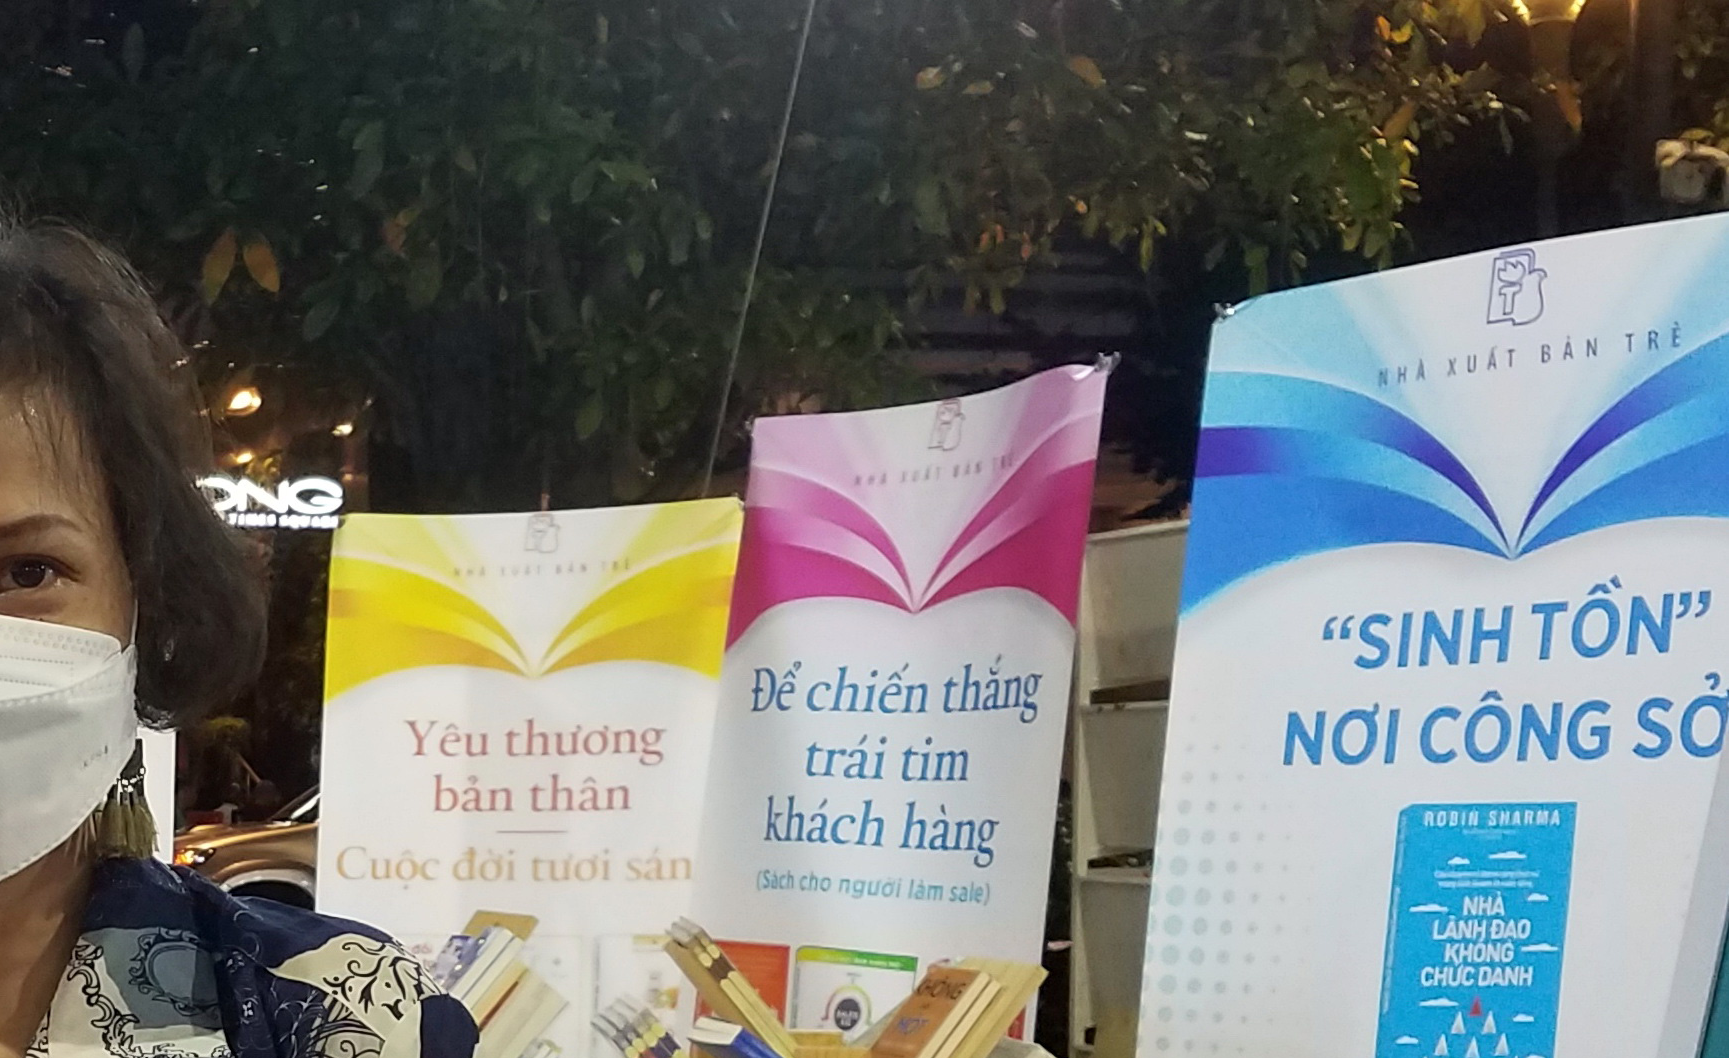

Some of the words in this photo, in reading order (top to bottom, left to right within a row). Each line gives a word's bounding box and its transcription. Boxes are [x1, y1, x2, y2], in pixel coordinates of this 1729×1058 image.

[1378, 362, 1428, 387] NHÀ
[1447, 345, 1517, 377] XUẤT
[1540, 336, 1599, 364] BẢN
[1625, 320, 1683, 353] TRẺ
[752, 661, 802, 712] Để
[806, 663, 928, 714] chiến
[943, 654, 1042, 724] thắng
[1283, 704, 1400, 766] NƠI
[1419, 691, 1612, 763] CÔNG
[1633, 672, 1729, 759] SỞ
[405, 719, 489, 758] Yêu
[505, 718, 667, 766] thương
[806, 735, 886, 780] trái
[901, 737, 968, 781] tim
[434, 774, 513, 813] bản
[530, 773, 632, 812] thân
[763, 796, 885, 847] khách
[899, 802, 999, 868] hàng
[1424, 810, 1479, 827] ROBIN
[1488, 809, 1561, 826] SHARMA
[336, 846, 438, 890] Cuộc
[452, 846, 516, 882] đời
[531, 848, 610, 882] tươi
[756, 870, 794, 890] (Sách
[799, 872, 831, 892] cho
[838, 876, 901, 898] người
[908, 879, 943, 900] làm
[949, 883, 991, 906] sale)
[1463, 890, 1505, 916] NHÀ
[1433, 916, 1486, 941] LÃNH
[1444, 938, 1514, 964] KHÔNG
[1421, 962, 1475, 987] CHỨC
[1478, 967, 1533, 987] DANH
